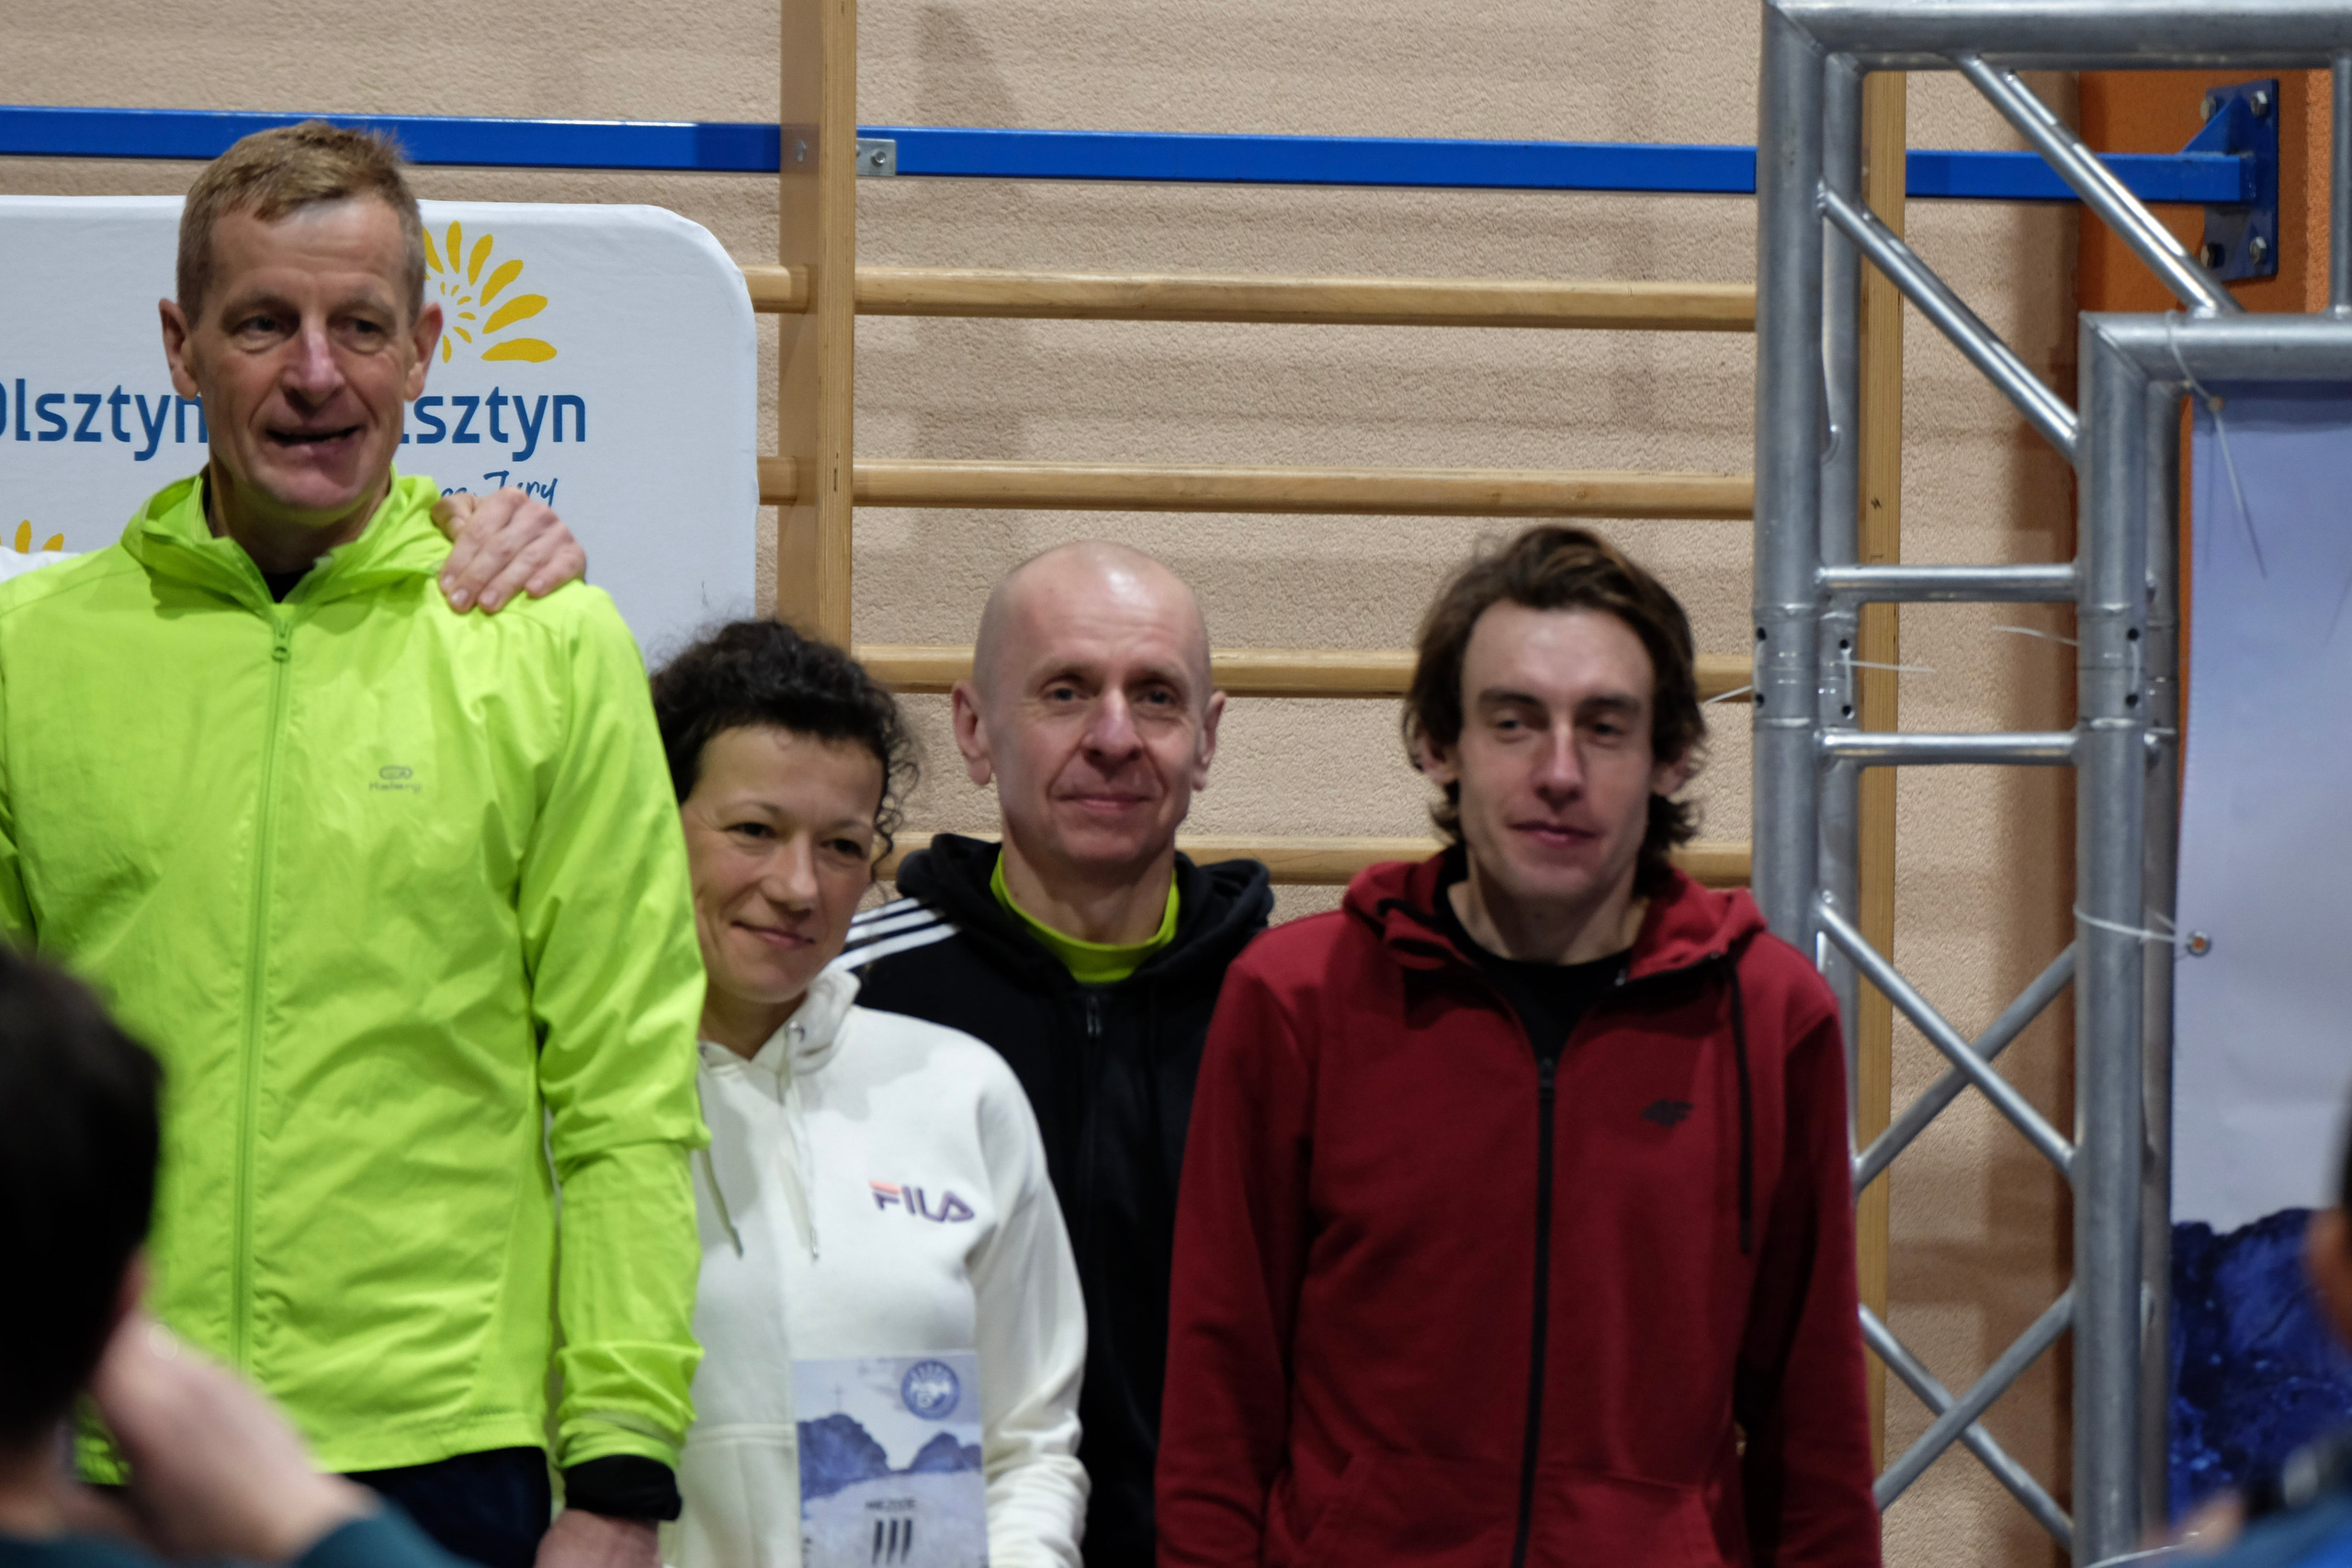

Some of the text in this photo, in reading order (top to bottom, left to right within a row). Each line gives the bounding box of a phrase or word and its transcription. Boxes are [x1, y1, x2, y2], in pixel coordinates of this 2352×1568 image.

[0, 378, 209, 461] lsztyn
[400, 386, 586, 462] sztyn
[482, 469, 559, 506] Jry
[868, 1179, 976, 1224] FILA
